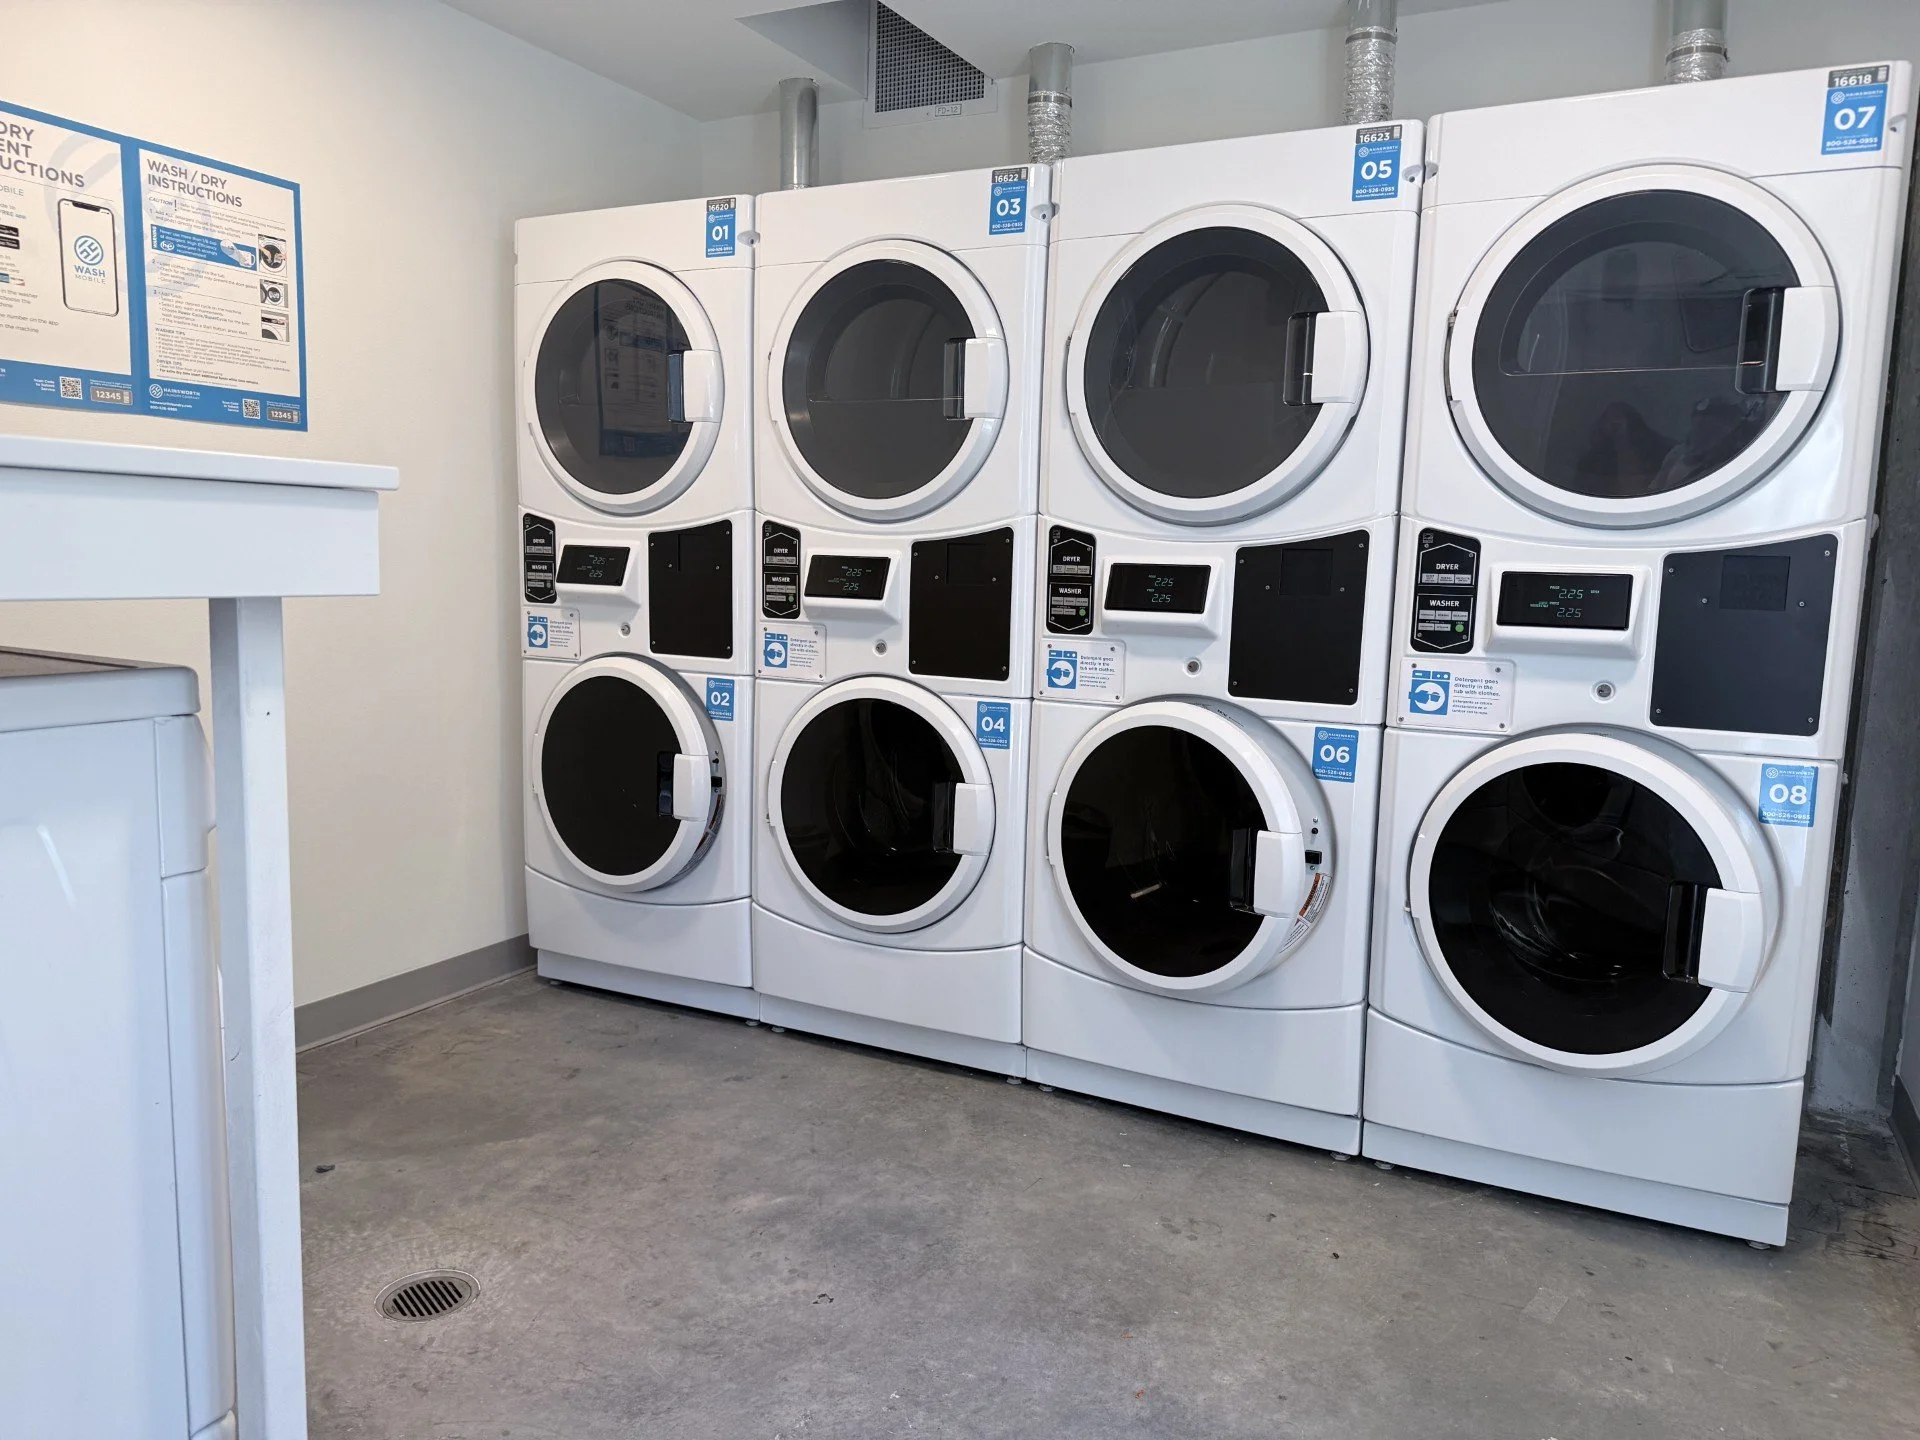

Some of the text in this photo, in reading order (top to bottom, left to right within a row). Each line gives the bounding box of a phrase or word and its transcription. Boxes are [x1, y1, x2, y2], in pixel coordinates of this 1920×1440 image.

[1834, 74, 1872, 86] 16618
[1834, 106, 1876, 130] 07
[1360, 132, 1390, 144] 16623
[147, 158, 188, 180] WASH
[200, 174, 228, 190] DRY
[1361, 160, 1392, 180] 05
[995, 174, 1018, 182] 16622
[148, 174, 242, 208] INSTRUCTIONS
[996, 198, 1020, 216] 03
[712, 225, 728, 240] 01
[74, 265, 106, 278] WASH
[75, 275, 106, 284] MOBILE
[96, 390, 121, 400] 12345
[164, 388, 200, 396] HAINSWORTH
[271, 410, 292, 420] 12345
[1558, 588, 1584, 599] 2.25
[711, 692, 730, 706] 02
[982, 716, 1005, 732] 04
[1320, 744, 1350, 764] 06
[1769, 784, 1807, 805] 08
